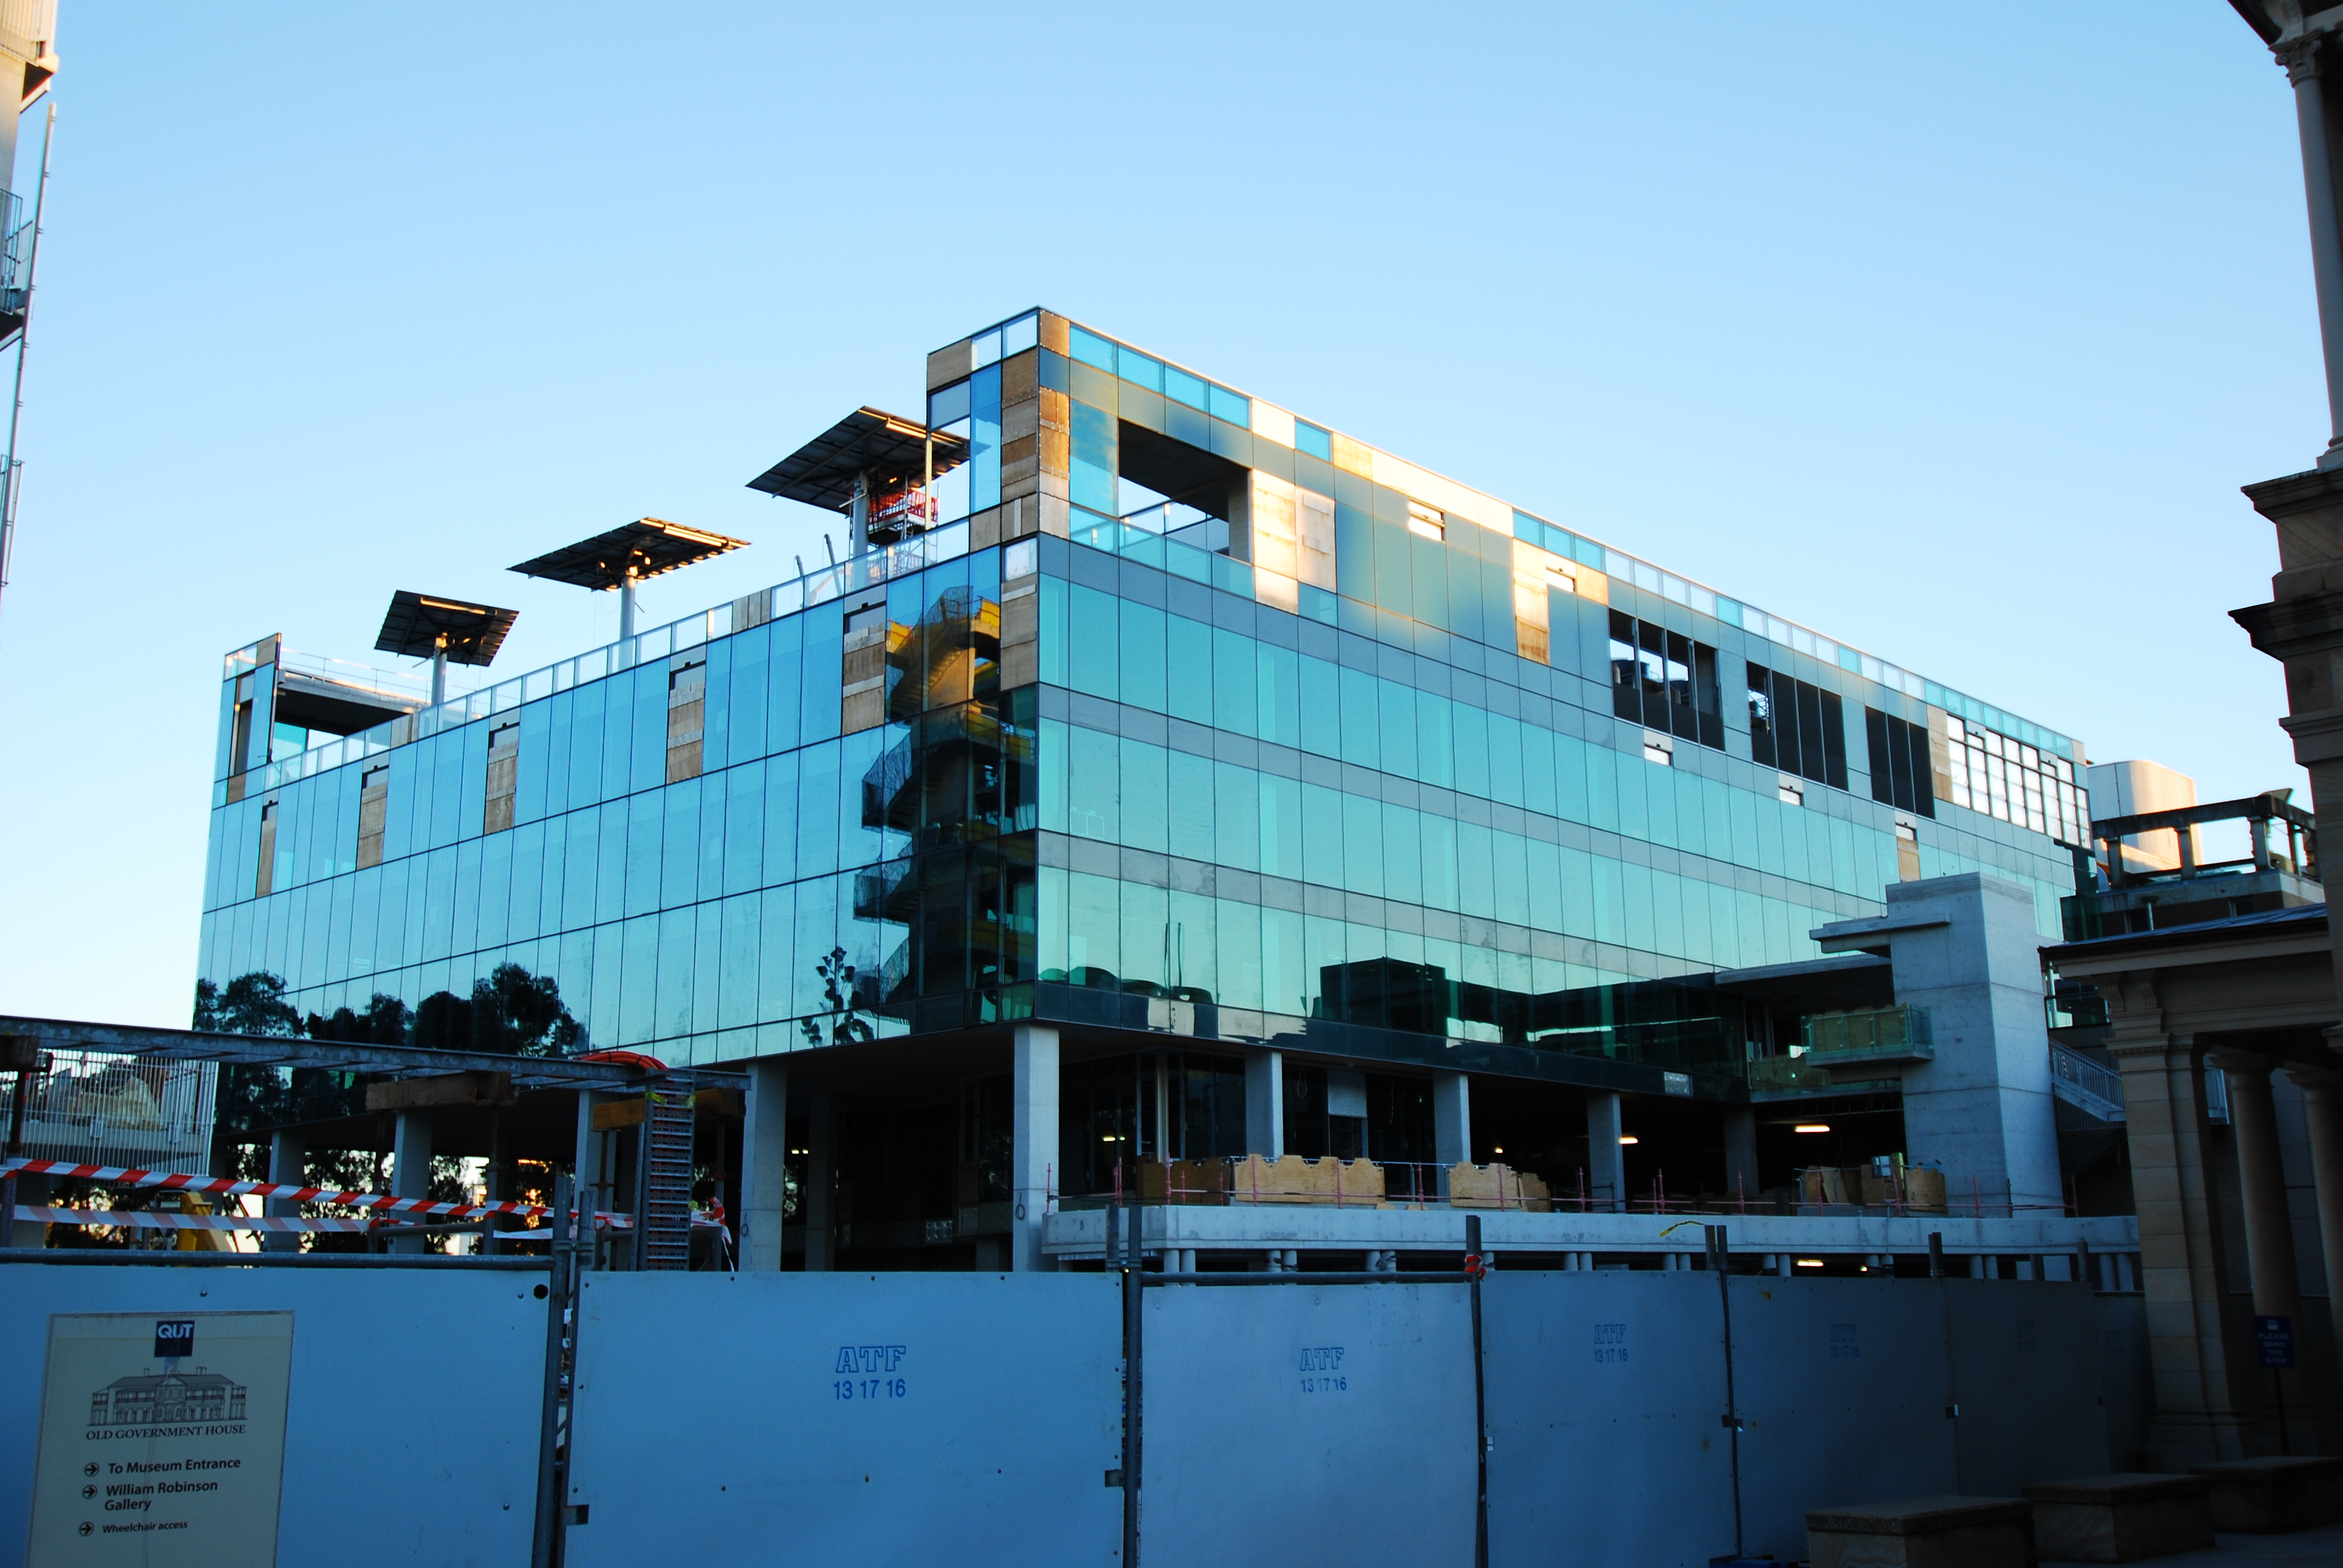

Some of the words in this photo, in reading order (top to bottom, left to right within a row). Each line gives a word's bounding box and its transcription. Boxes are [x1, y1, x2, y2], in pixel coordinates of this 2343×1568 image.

[157, 1324, 193, 1339] QUT
[1594, 1324, 1626, 1344] ATF
[836, 1346, 906, 1373] ATF
[1300, 1348, 1344, 1370] ATF
[1594, 1349, 1603, 1363] 13
[1606, 1349, 1614, 1362] 17
[1618, 1348, 1627, 1361] 16
[834, 1380, 853, 1399] 13
[860, 1380, 879, 1398] 17
[887, 1379, 905, 1397] 16
[1300, 1378, 1314, 1392] 13
[1317, 1377, 1330, 1391] 17
[1333, 1377, 1346, 1390] 16
[86, 1429, 113, 1440] OLD
[116, 1427, 203, 1439] GOVERNMENT
[205, 1425, 246, 1436] HOUSE
[108, 1462, 123, 1475] To
[127, 1461, 182, 1474] Museum
[186, 1459, 241, 1471] Entrance
[106, 1485, 155, 1497] William
[159, 1481, 218, 1495] Robinson
[105, 1498, 151, 1513] Gallery
[102, 1521, 156, 1534] Wheelchair
[159, 1520, 188, 1530] access
